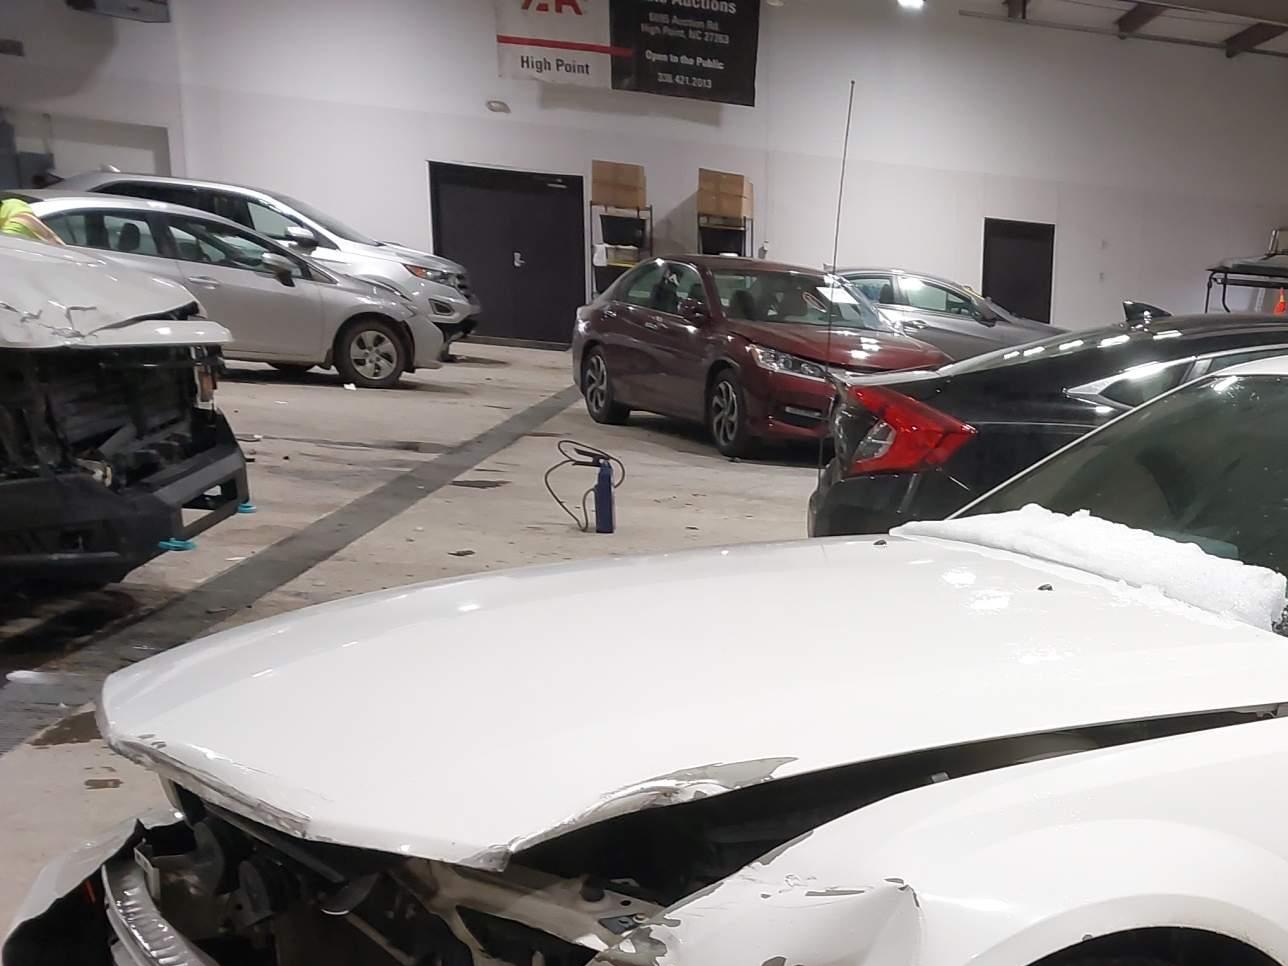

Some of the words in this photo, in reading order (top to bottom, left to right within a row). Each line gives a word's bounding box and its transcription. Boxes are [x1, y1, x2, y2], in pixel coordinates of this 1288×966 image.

[520, 55, 552, 73] High
[555, 58, 590, 75] Point
[645, 49, 669, 62] Open
[669, 54, 679, 63] to
[680, 55, 695, 65] the
[696, 56, 726, 69] Public
